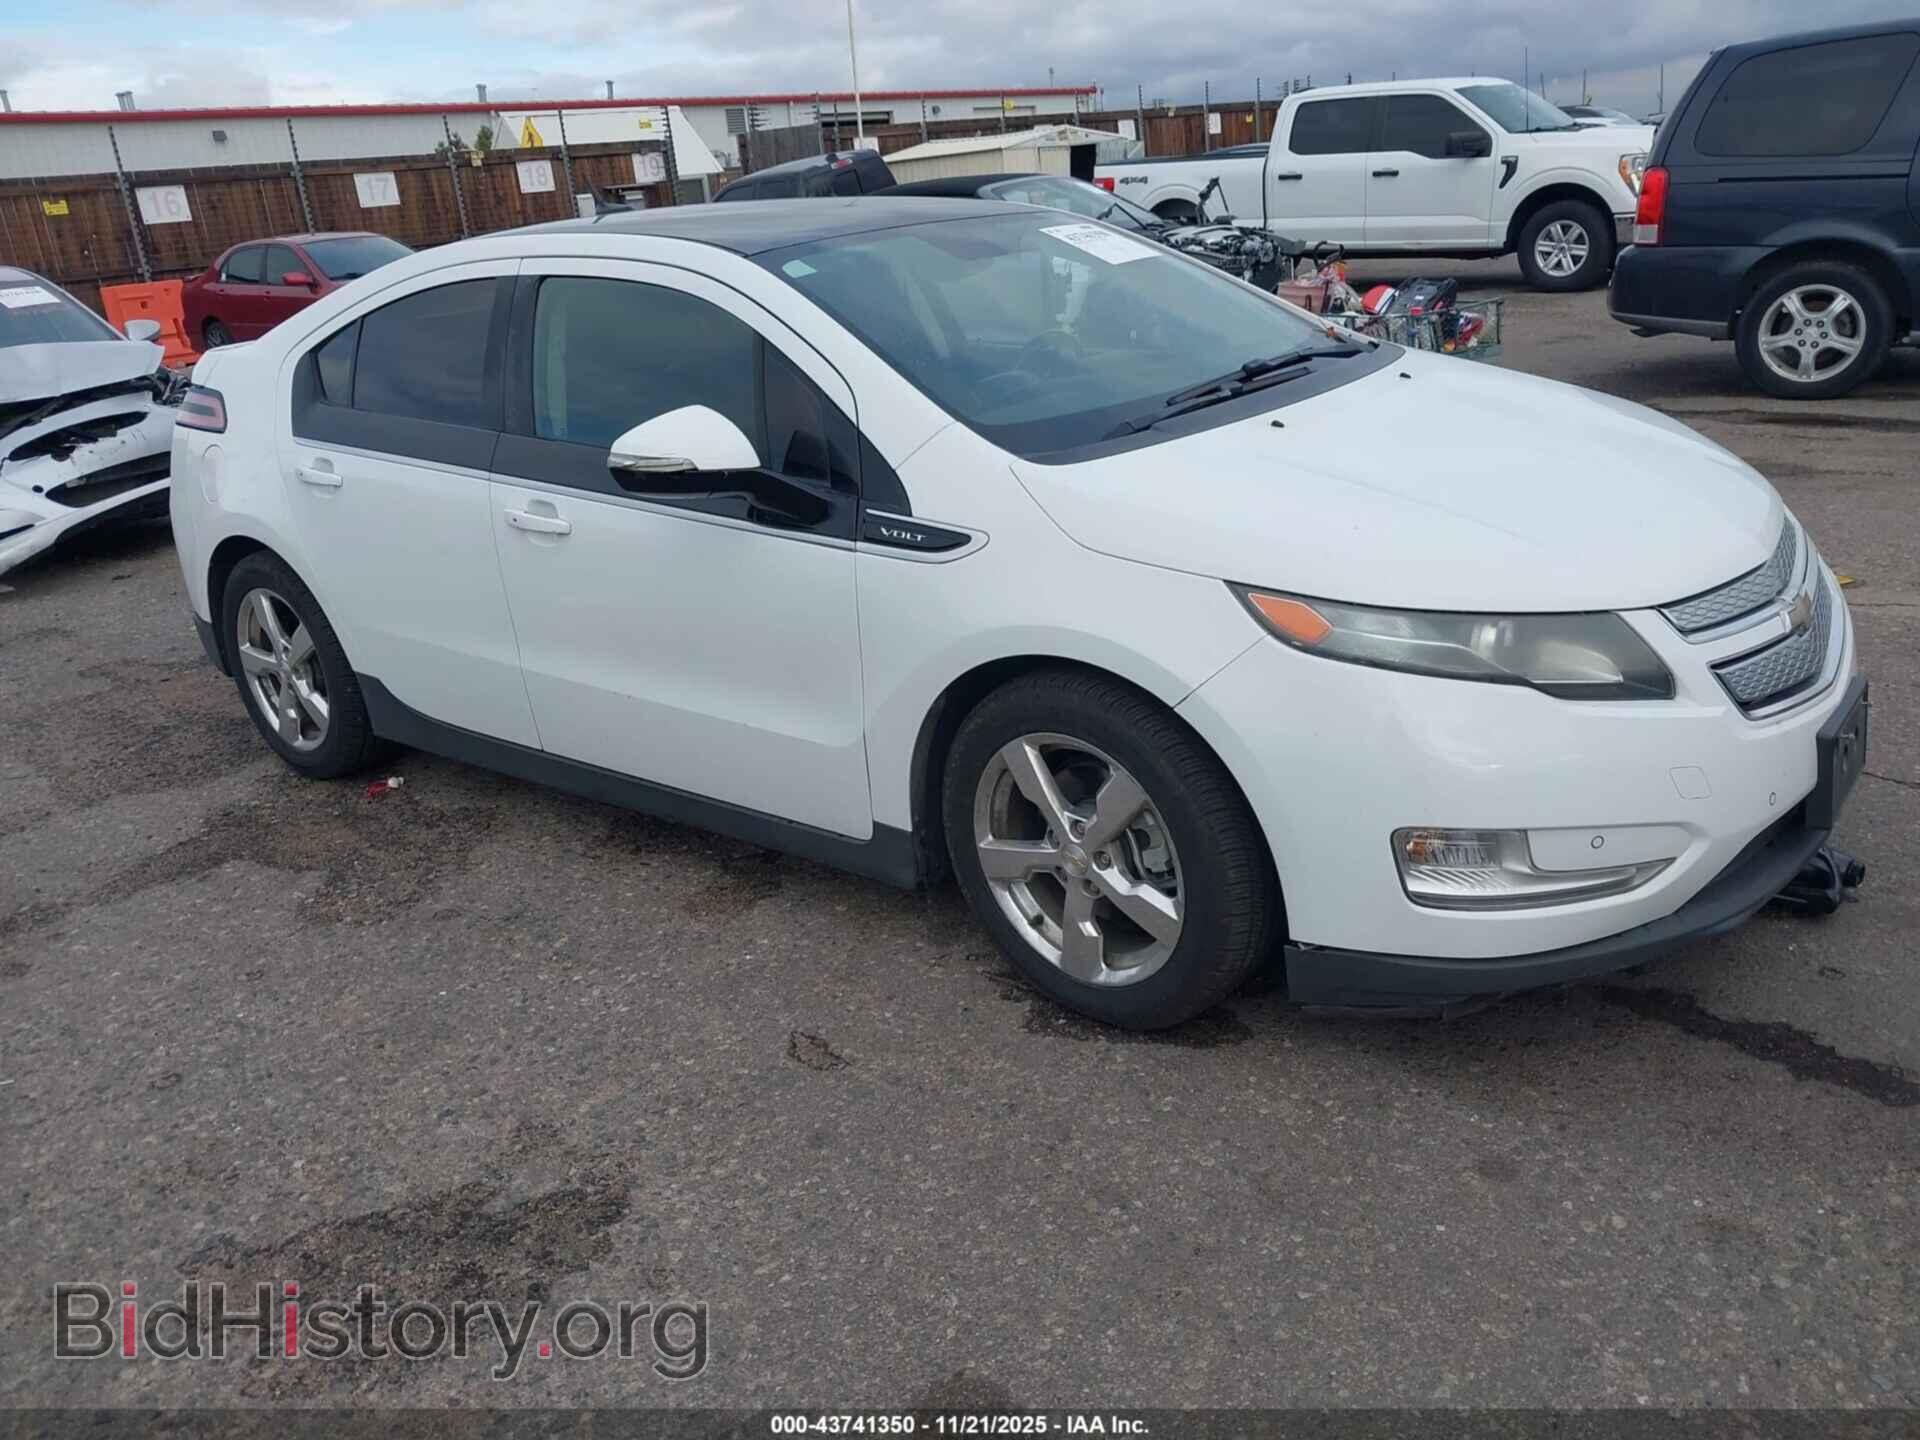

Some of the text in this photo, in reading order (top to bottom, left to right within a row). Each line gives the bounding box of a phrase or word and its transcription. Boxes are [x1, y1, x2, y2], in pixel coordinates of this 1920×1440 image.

[527, 165, 547, 187] 18
[638, 154, 660, 177] 19
[365, 178, 389, 201] 17
[151, 190, 181, 217] 16
[880, 526, 927, 542] VOLT
